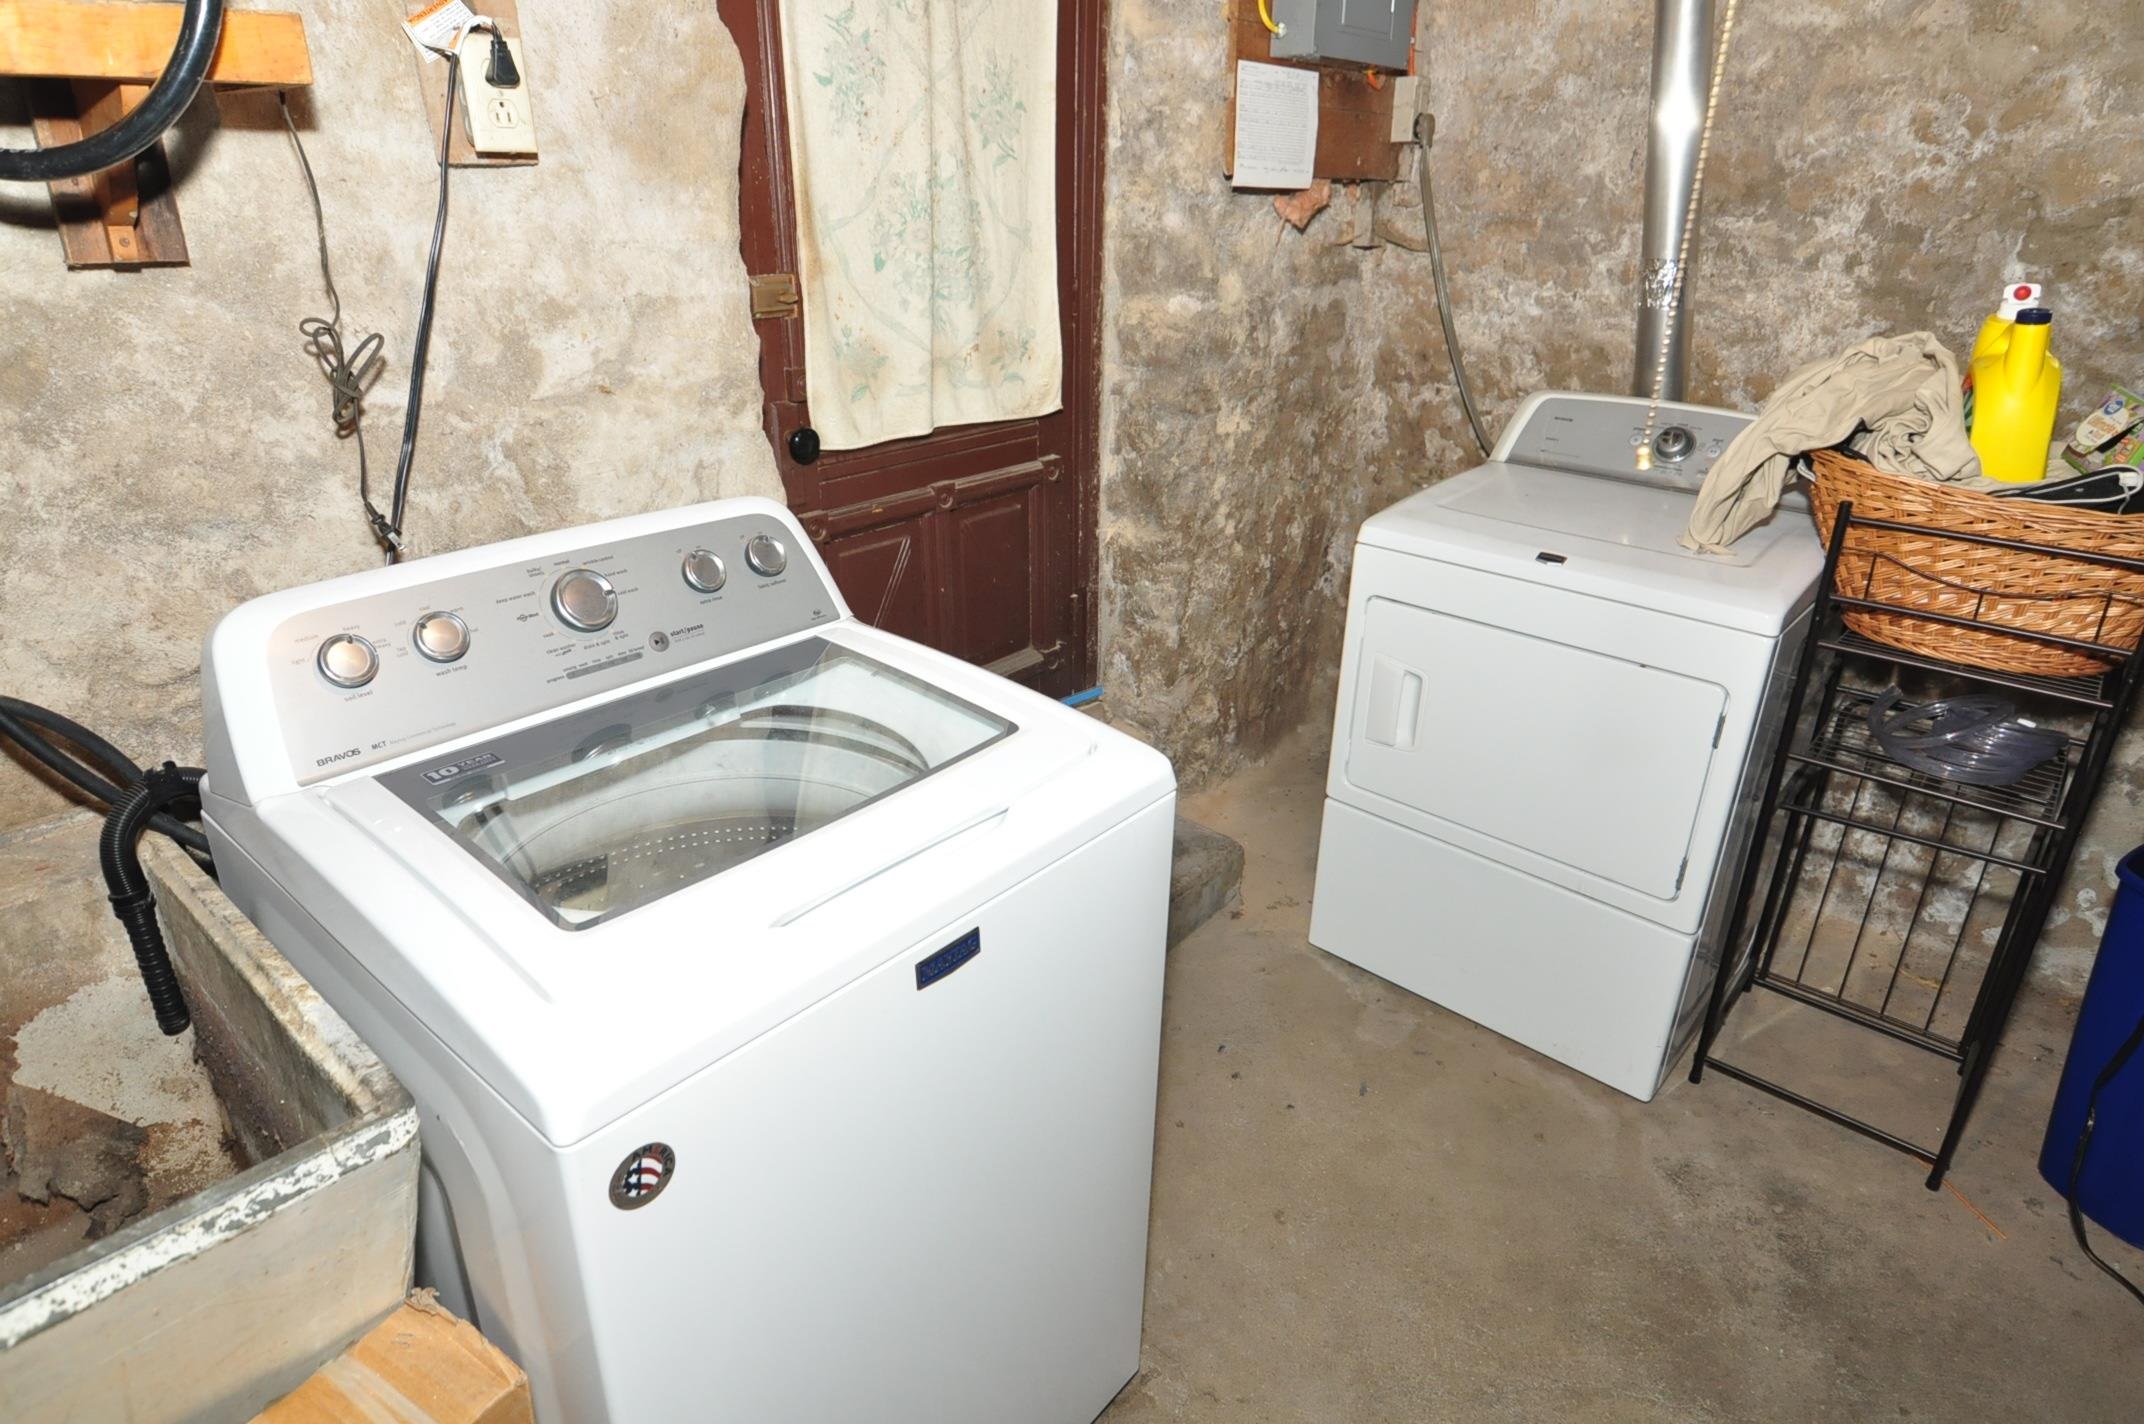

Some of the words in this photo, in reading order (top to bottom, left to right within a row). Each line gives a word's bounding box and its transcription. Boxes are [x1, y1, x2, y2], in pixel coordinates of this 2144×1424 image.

[670, 623, 704, 638] start/pause
[316, 748, 361, 767] BRAVOS
[371, 740, 387, 751] MCT
[427, 766, 460, 780] 10
[632, 1143, 674, 1178] AMERICA
